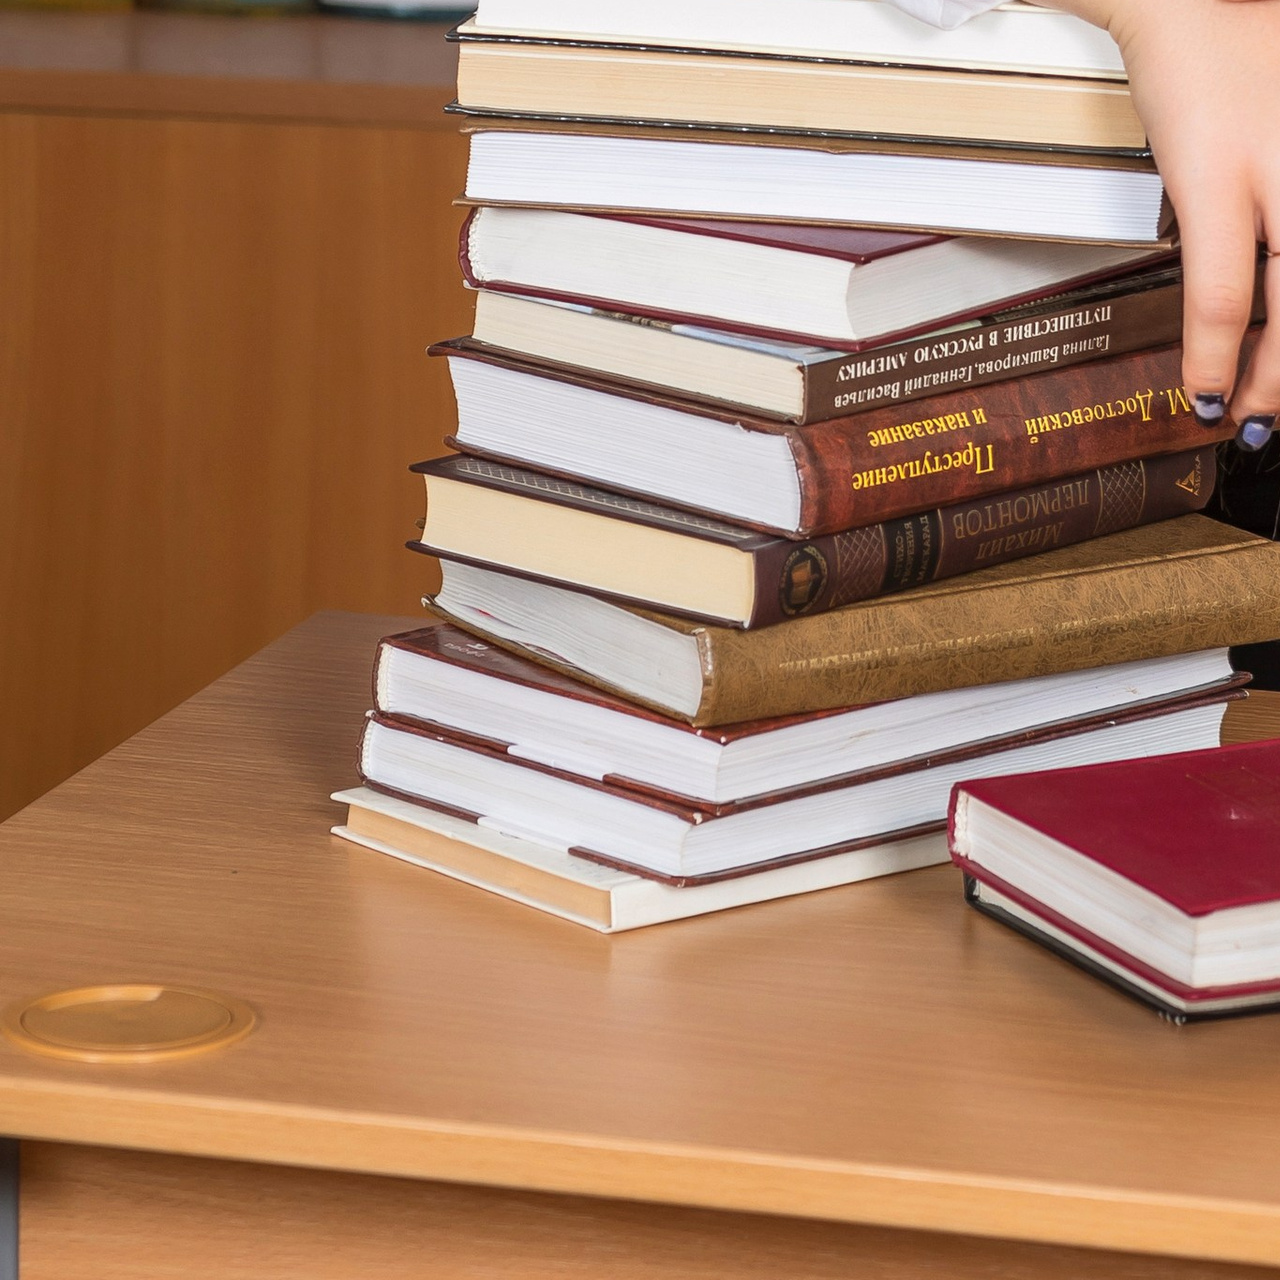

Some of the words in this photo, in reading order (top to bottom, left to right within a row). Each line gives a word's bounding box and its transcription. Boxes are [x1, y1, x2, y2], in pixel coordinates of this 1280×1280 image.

[989, 329, 999, 347] В
[1003, 305, 1111, 344] ПУТЕШЕСТВИЕ
[914, 331, 984, 364] РУССКУЮ
[1062, 334, 1111, 356] Галина
[835, 353, 908, 382] АМЕРИКУ
[904, 364, 973, 395] Геннадий
[834, 380, 900, 409] Васильев
[867, 413, 970, 449] наказание
[973, 408, 988, 428] и
[1024, 387, 1155, 444] Достоевский
[851, 443, 995, 490] Преступление
[952, 478, 1091, 540] ЛЕРМОНТОВ
[976, 521, 1064, 560] Михаил
